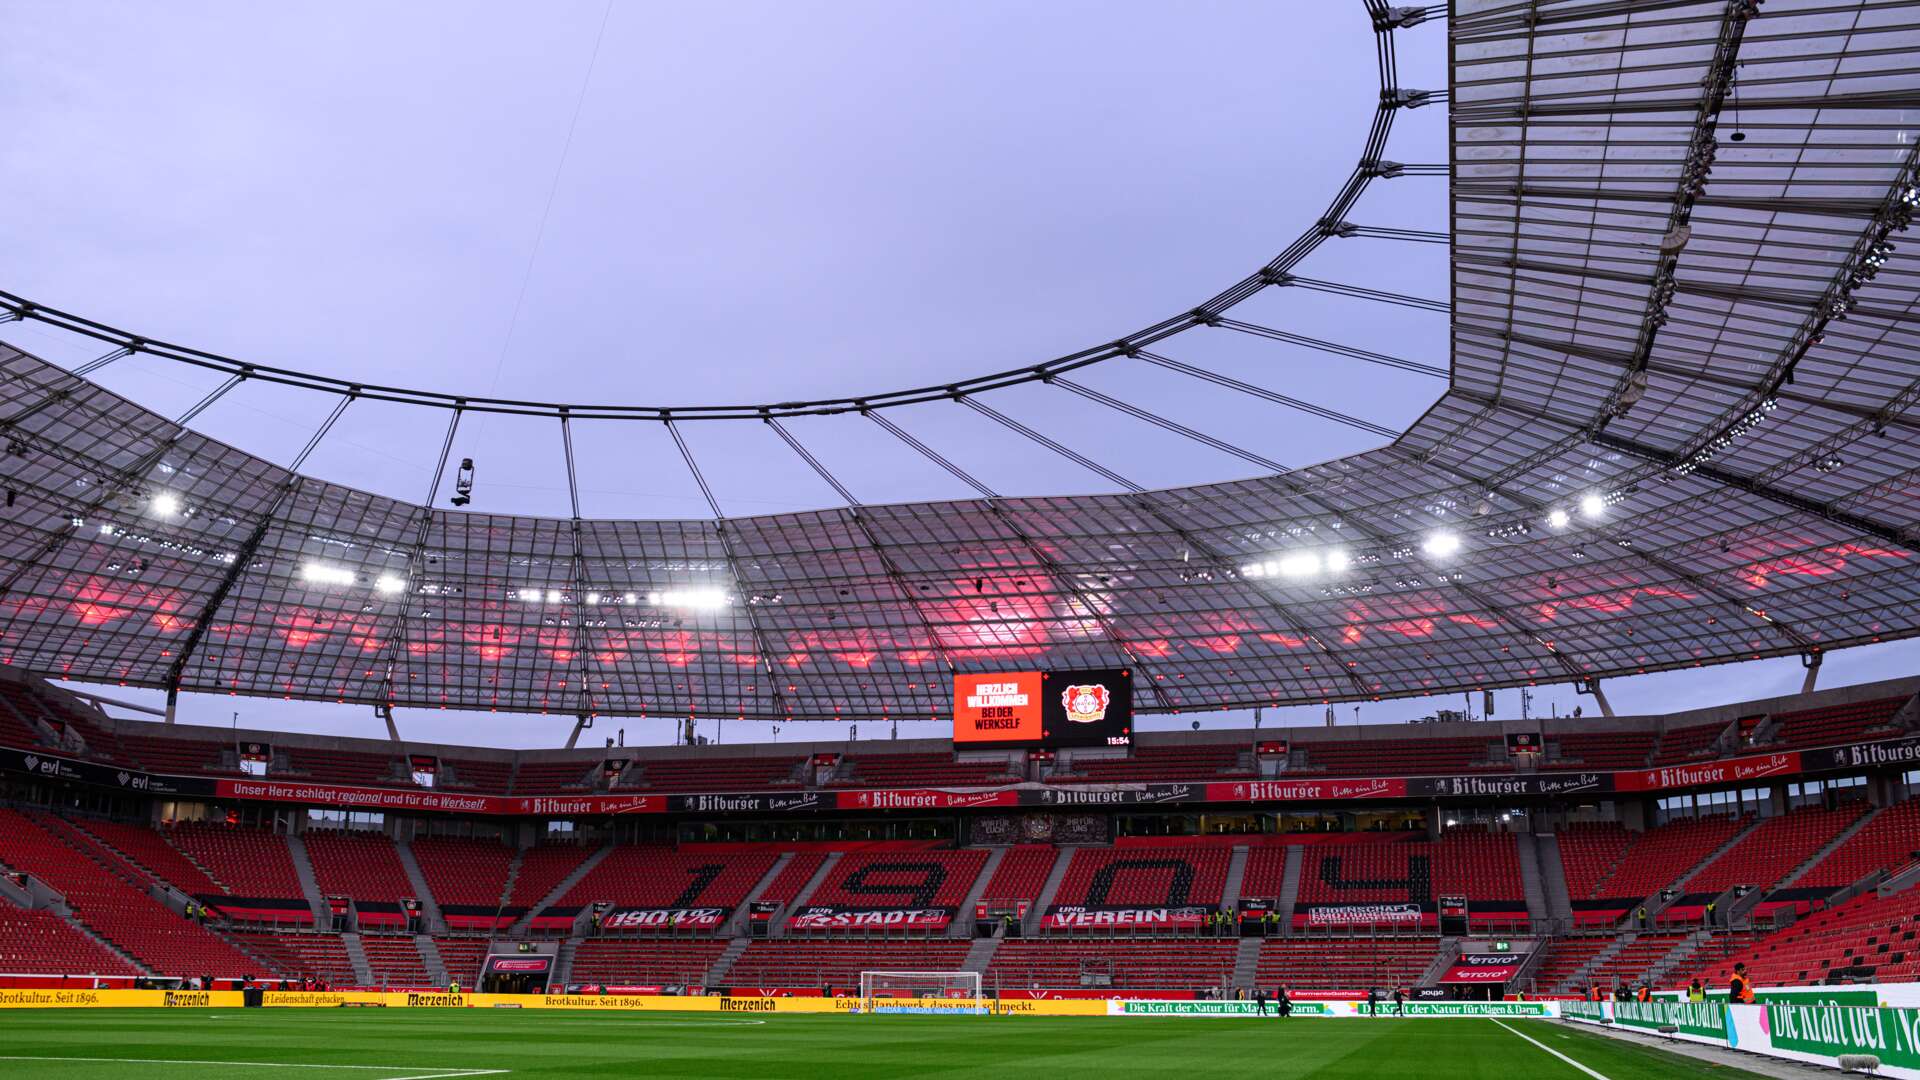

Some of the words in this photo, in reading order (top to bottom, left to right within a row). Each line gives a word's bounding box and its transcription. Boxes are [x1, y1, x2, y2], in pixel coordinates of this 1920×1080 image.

[976, 682, 1018, 695] HERZLICH
[967, 694, 1029, 708] WILLKOMMEN
[981, 707, 996, 718] BEI
[997, 707, 1013, 718] DER
[975, 718, 1021, 730] WERKSELF
[1107, 737, 1130, 745] 15:54
[40, 759, 60, 775] evl
[131, 775, 149, 790] evl
[1660, 767, 1725, 787] Bitburger
[1249, 782, 1321, 799] Bitburger
[1452, 777, 1528, 795] Bitburger
[234, 783, 267, 796] Unser
[268, 785, 293, 797] Herz
[295, 787, 336, 801] schlägt
[337, 790, 383, 804] regional
[383, 793, 403, 805] und
[405, 794, 421, 806] für
[422, 795, 439, 807] die
[440, 796, 488, 810] Werkself.
[698, 795, 760, 811] Bitburger
[872, 791, 937, 808] Bitburger
[533, 798, 592, 813] Bitburger
[833, 910, 923, 925] STADT
[1054, 909, 1168, 926] VEREIN
[0, 991, 52, 1004] Brotkultur.
[55, 992, 74, 1004] Seit
[76, 992, 100, 1005] 1896.
[163, 991, 210, 1007] Merzenich
[271, 993, 314, 1004] Leidenschaft
[407, 993, 463, 1007] Merzenich
[545, 996, 598, 1007] Brotkultur.
[599, 996, 618, 1007] Seit
[619, 997, 644, 1008] 1896.
[719, 997, 776, 1011] Merzenich
[1129, 1003, 1146, 1013] Die
[1147, 1003, 1173, 1013] Kraft
[1175, 1003, 1191, 1013] der
[1192, 1003, 1222, 1013] Natur
[1224, 1003, 1239, 1013] für
[1362, 1004, 1380, 1014] De
[1411, 1004, 1429, 1014] der
[1430, 1004, 1461, 1014] Natur
[1463, 1004, 1479, 1014] für
[1480, 1005, 1506, 1015] Magen
[1506, 1006, 1515, 1014] &
[1515, 1006, 1540, 1015] Darm.
[1773, 1005, 1799, 1040] Die
[1800, 1006, 1849, 1046] Kraft
